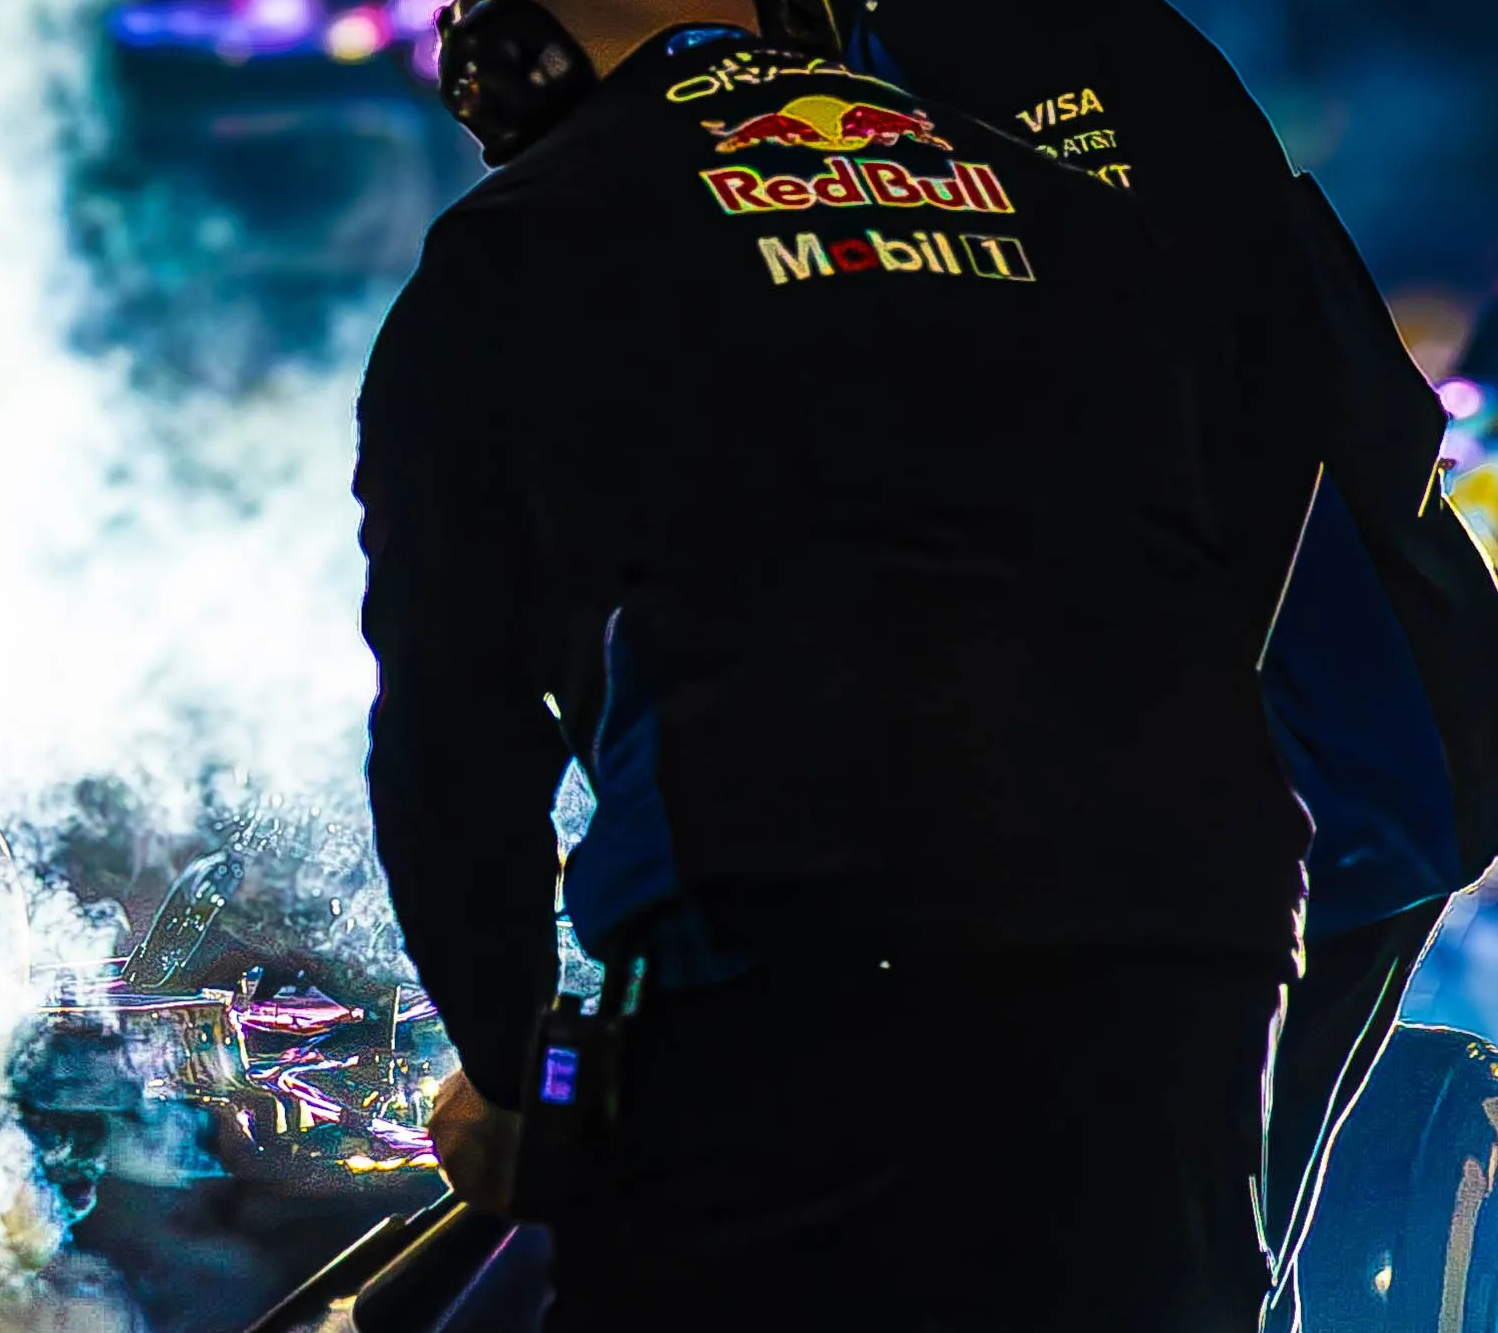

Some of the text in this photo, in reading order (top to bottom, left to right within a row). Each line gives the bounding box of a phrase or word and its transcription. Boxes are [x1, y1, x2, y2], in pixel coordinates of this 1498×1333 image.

[1014, 87, 1105, 134] VISA
[1062, 128, 1118, 159] AT&T
[699, 155, 1016, 215] Red Bull
[757, 227, 963, 286] Mobil
